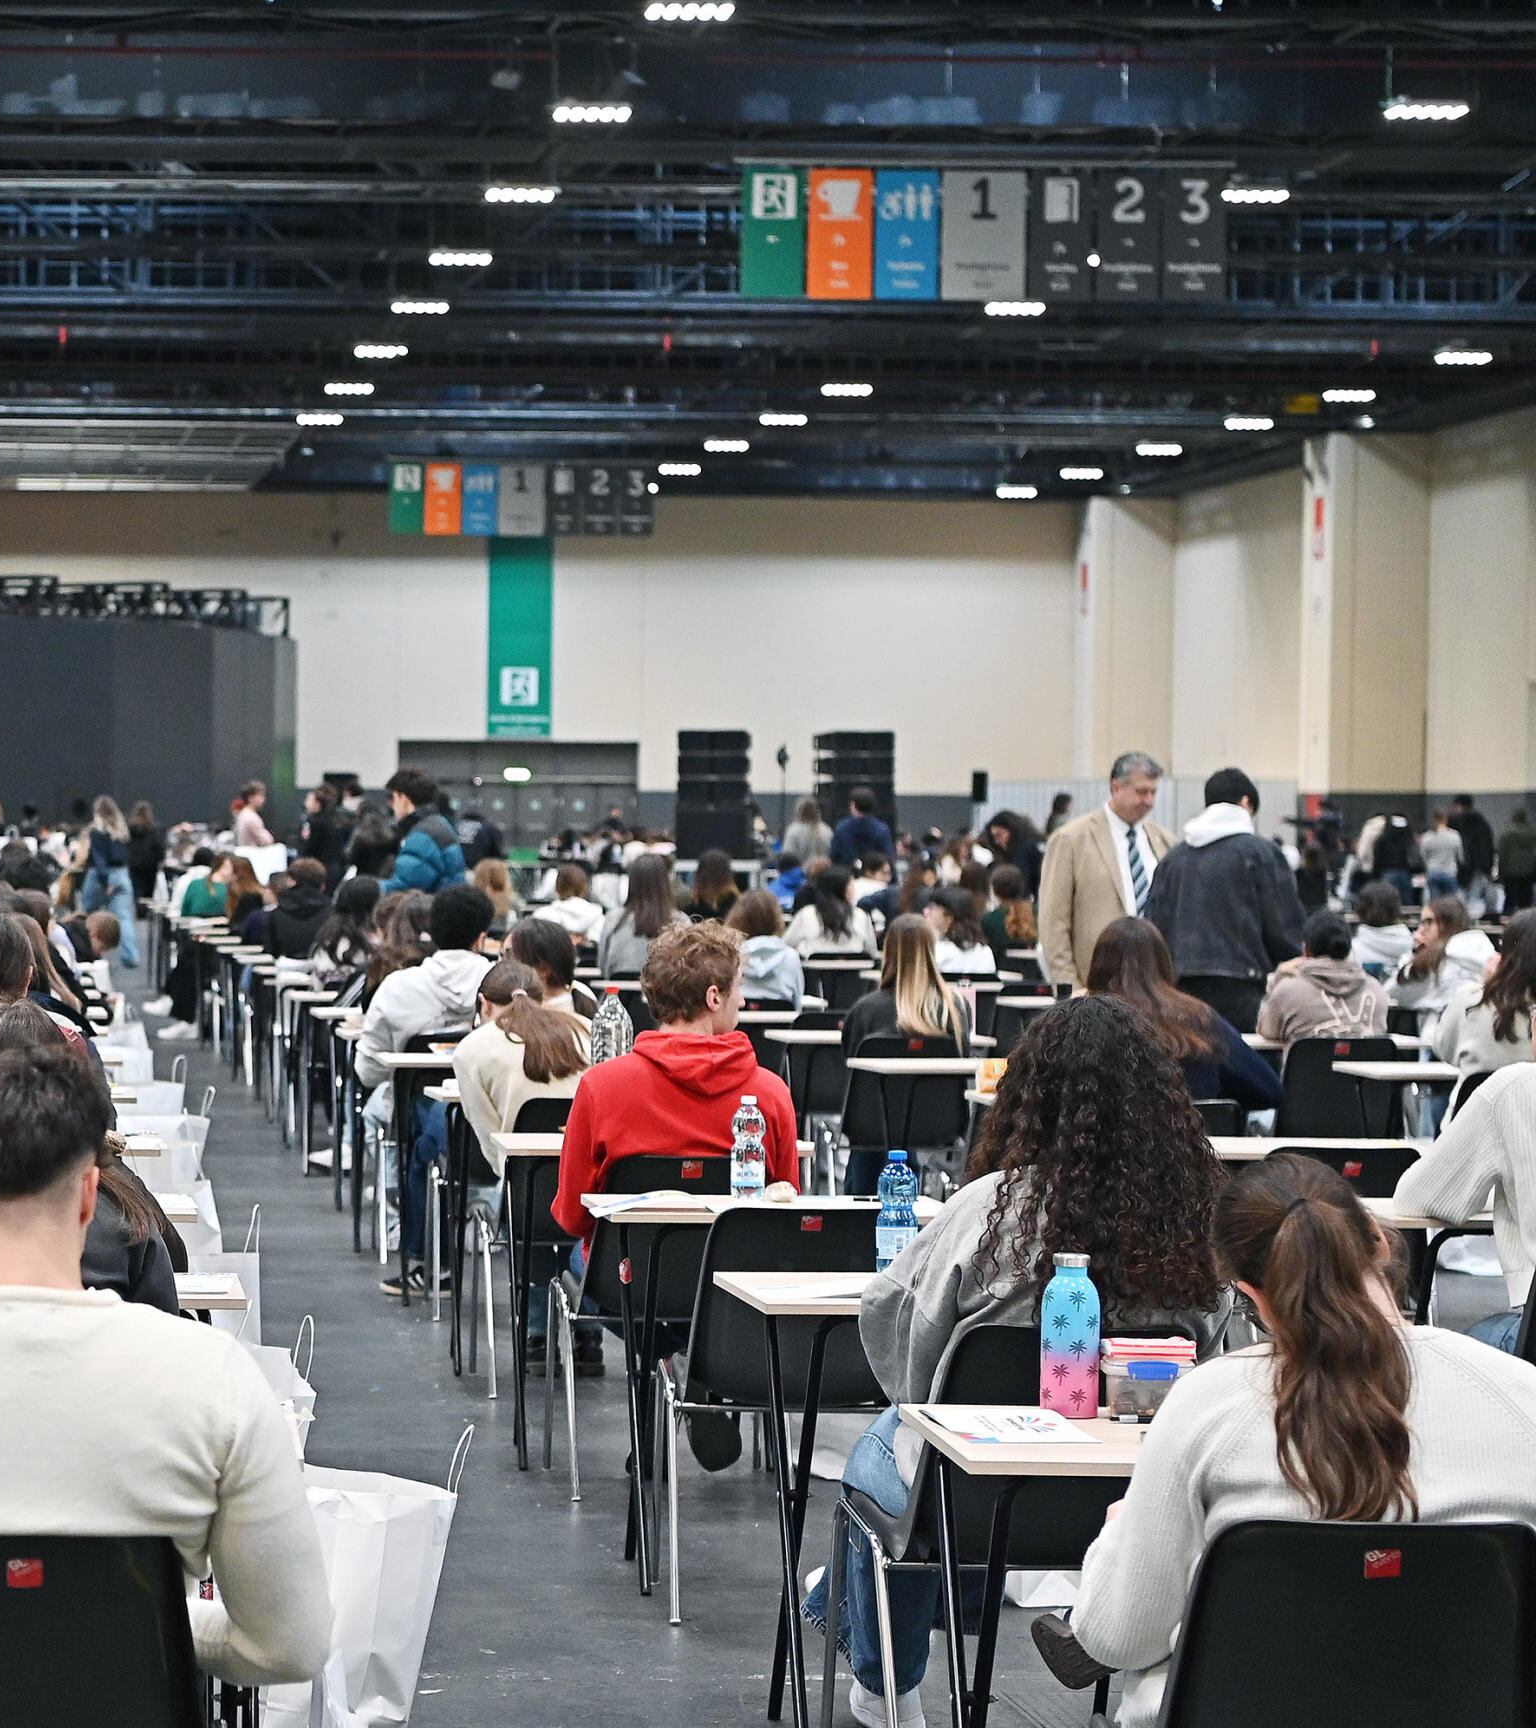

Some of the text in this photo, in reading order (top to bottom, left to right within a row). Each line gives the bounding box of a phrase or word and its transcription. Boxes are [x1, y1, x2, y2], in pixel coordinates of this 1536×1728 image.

[971, 177, 997, 220] 1
[1112, 177, 1146, 224] 2
[1179, 178, 1210, 224] 3
[513, 468, 528, 492] 1
[589, 468, 610, 495] 2
[627, 469, 646, 497] 3
[1365, 1550, 1386, 1562] GL
